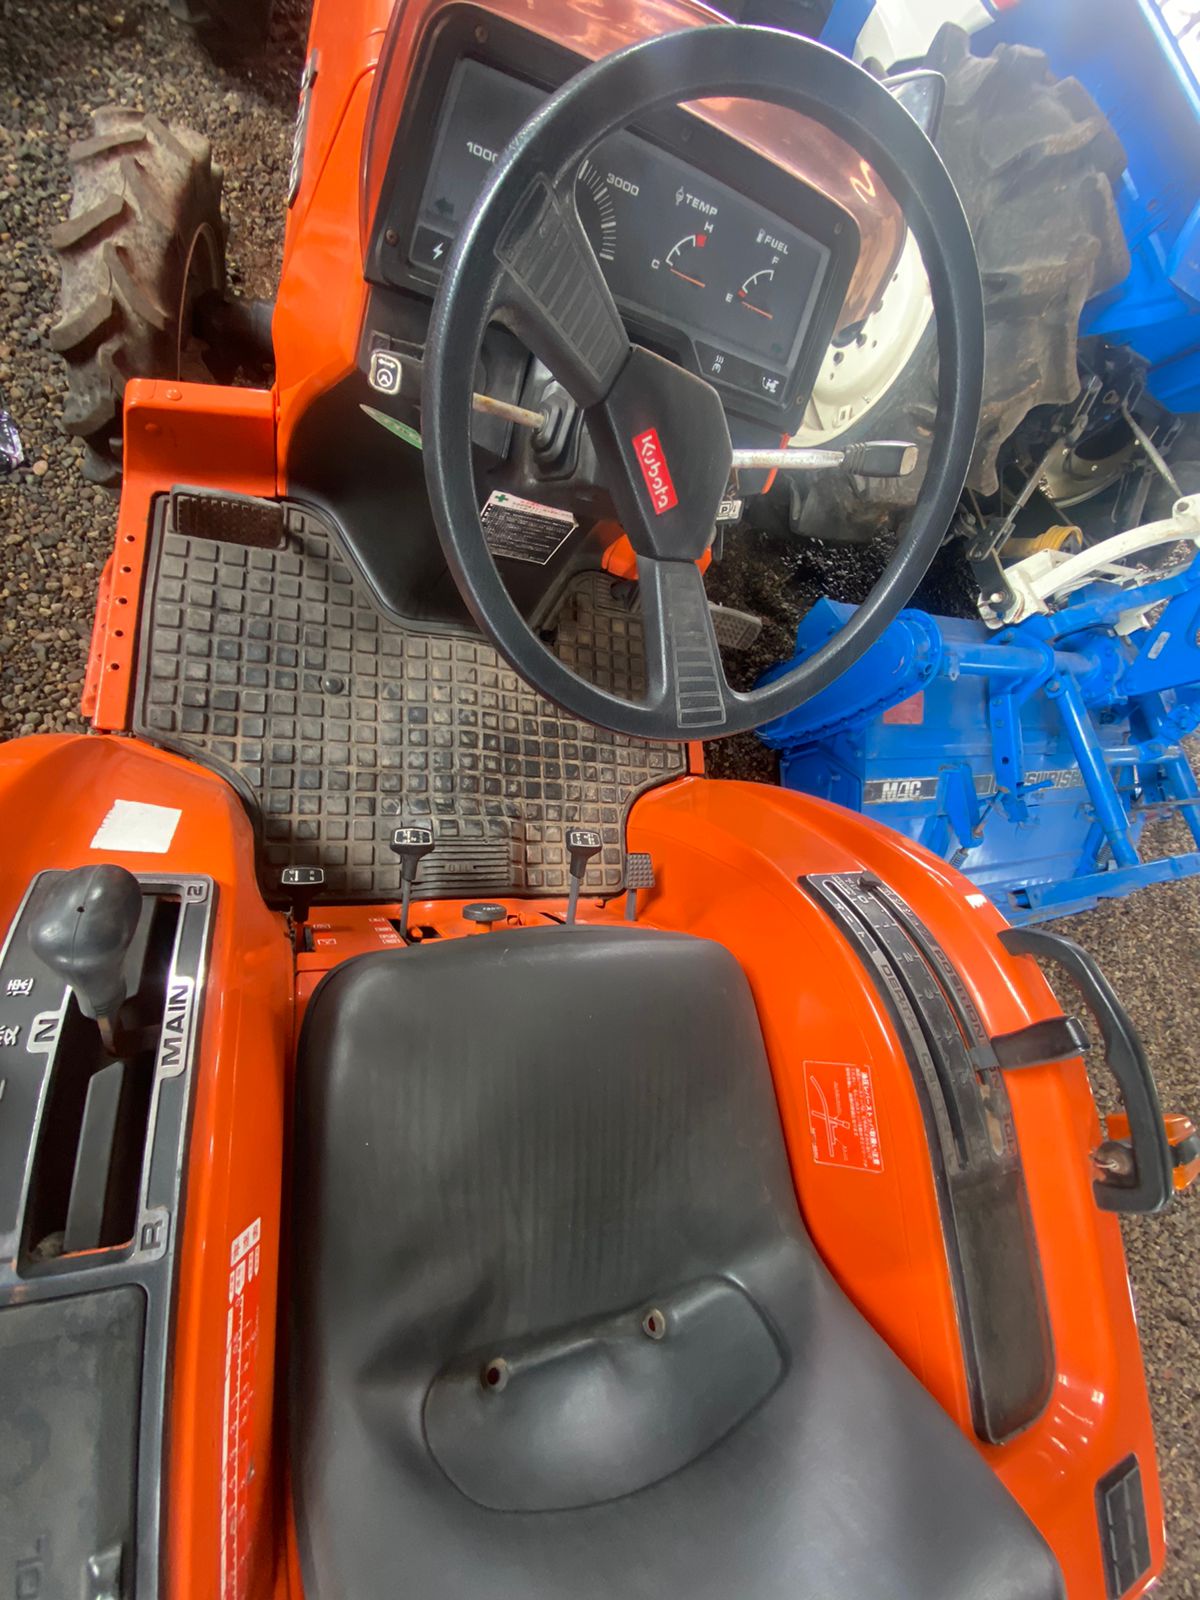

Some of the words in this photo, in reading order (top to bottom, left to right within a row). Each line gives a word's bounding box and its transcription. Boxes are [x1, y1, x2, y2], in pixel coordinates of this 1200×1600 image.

[606, 172, 640, 196] 3000
[685, 193, 718, 216] TEMP
[703, 221, 714, 233] H
[764, 235, 789, 255] FUEL
[651, 258, 660, 270] C
[772, 256, 780, 265] F
[725, 292, 733, 302] E
[641, 434, 669, 508] Kubota
[882, 782, 922, 800] MAC
[187, 885, 204, 897] 2
[934, 948, 986, 1039] POSITION
[34, 1018, 60, 1043] N
[162, 984, 188, 1067] MAIN
[140, 1219, 163, 1251] R
